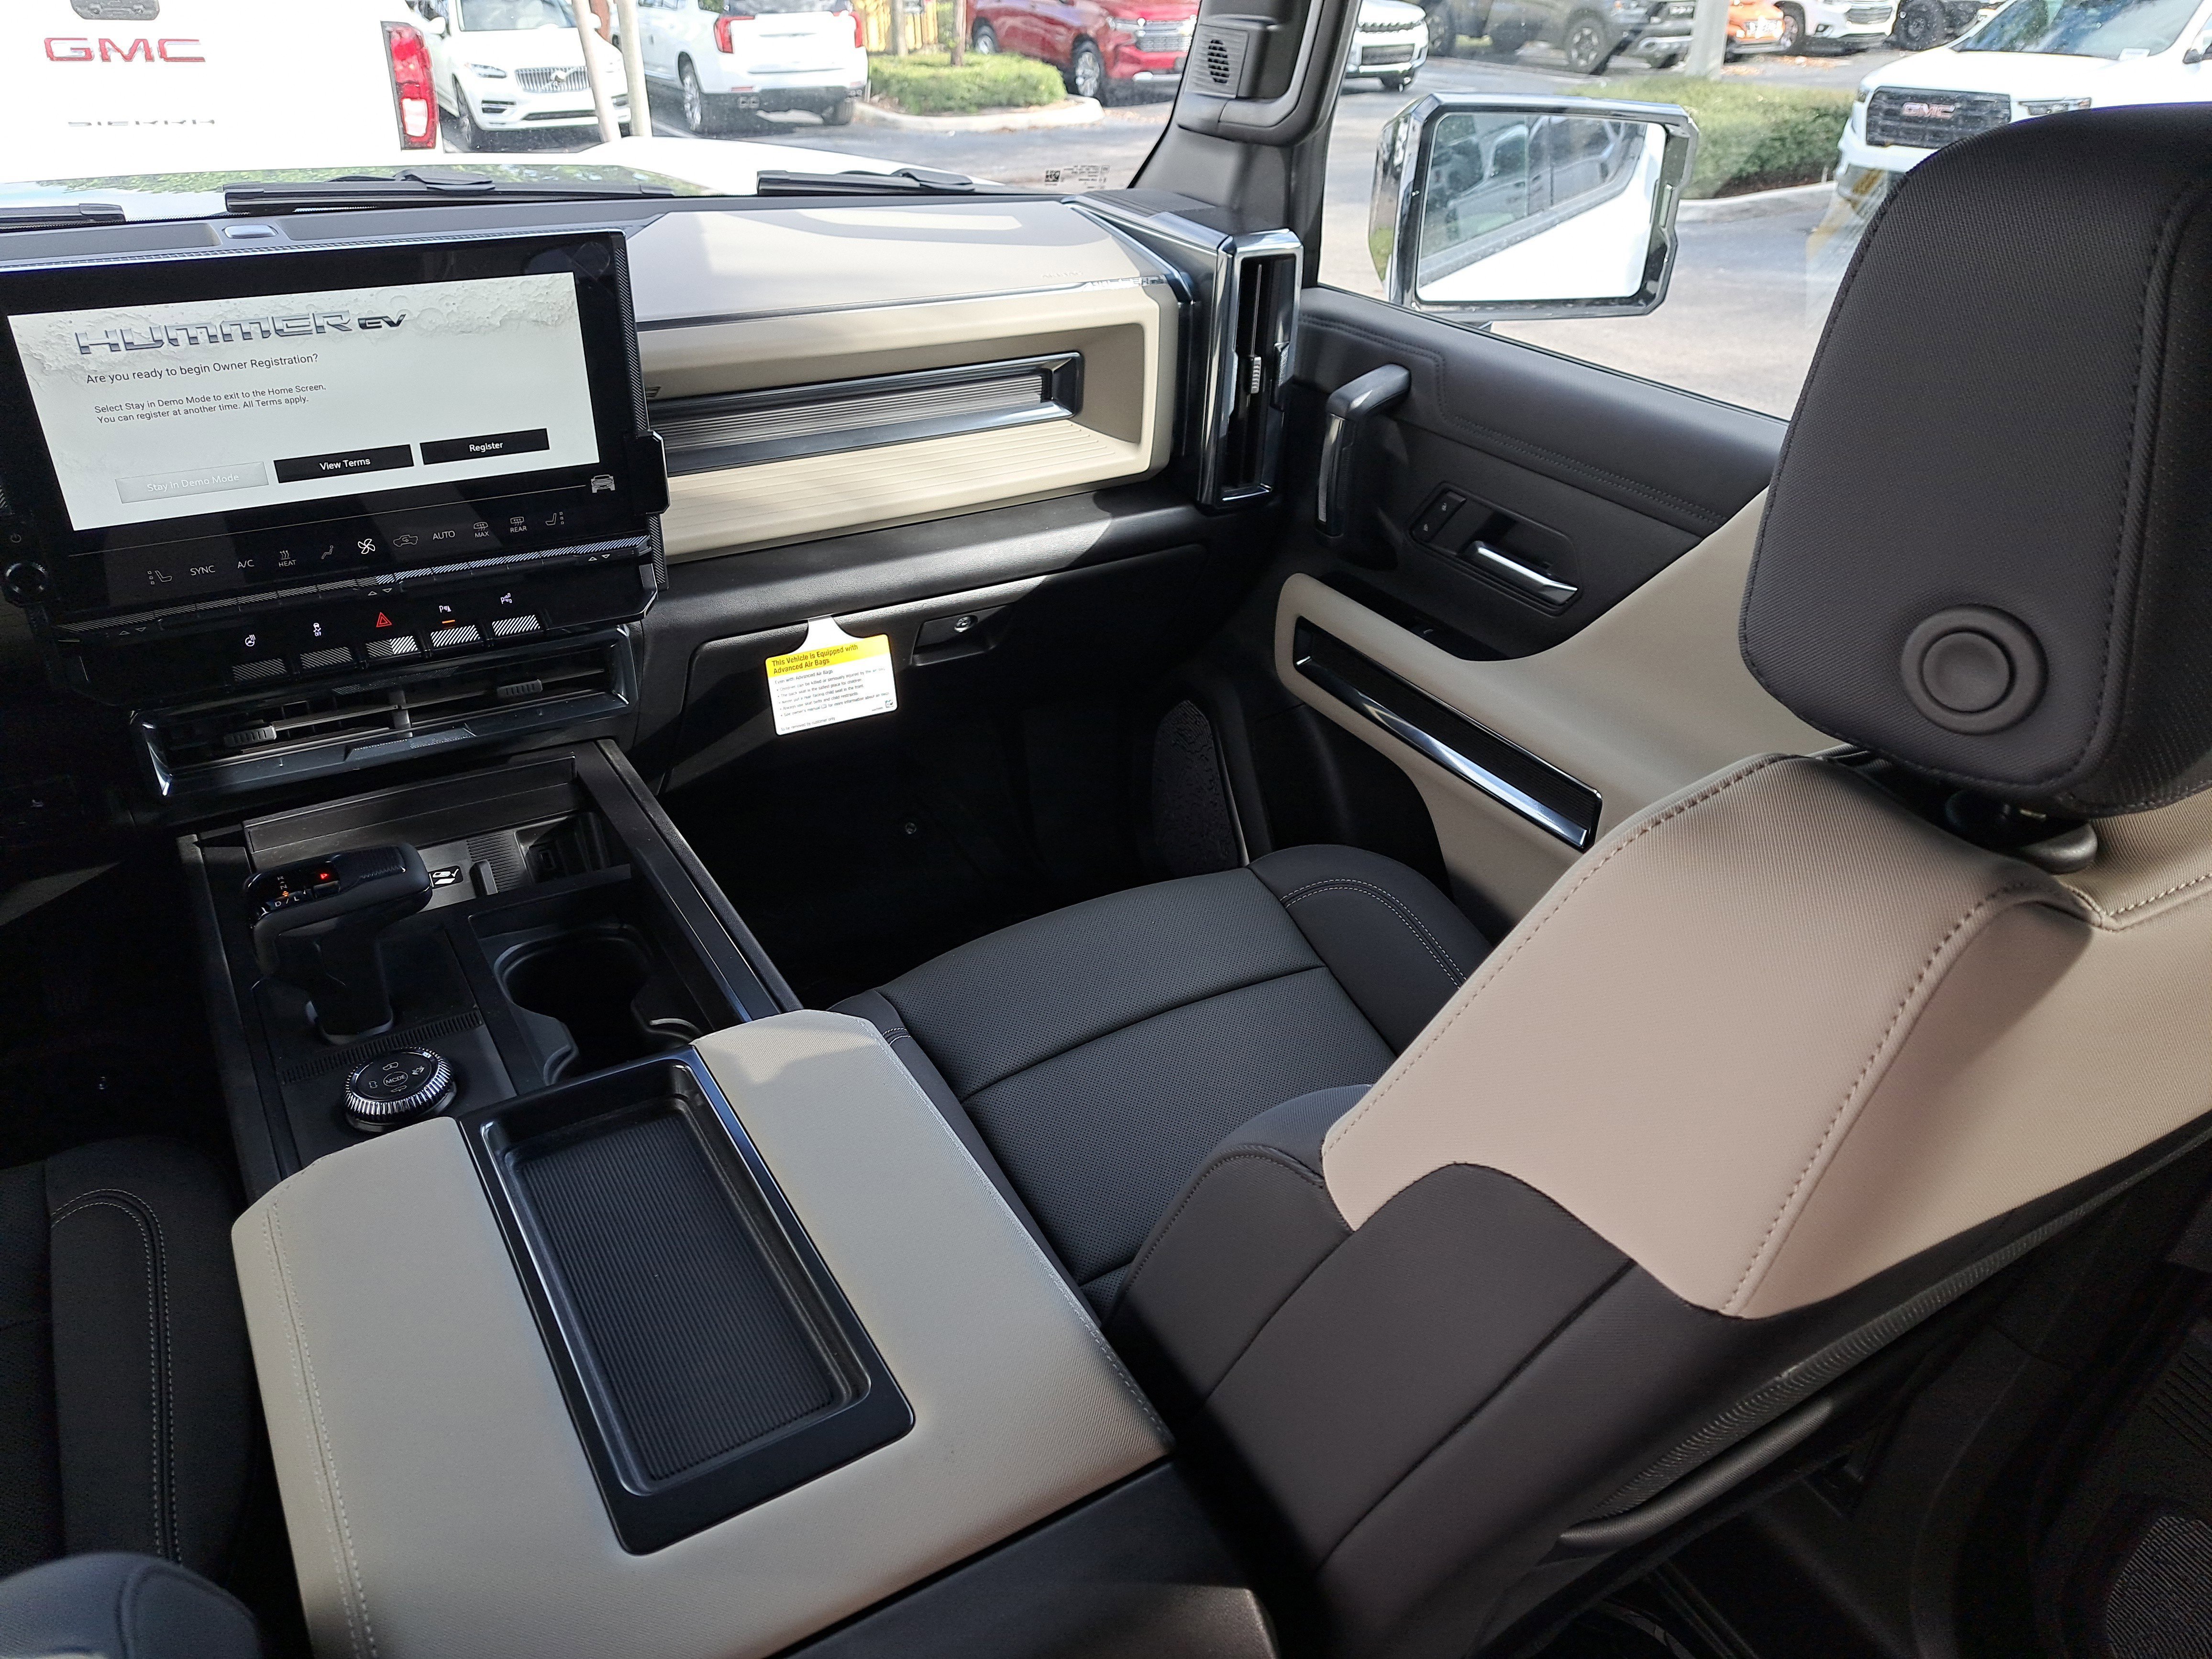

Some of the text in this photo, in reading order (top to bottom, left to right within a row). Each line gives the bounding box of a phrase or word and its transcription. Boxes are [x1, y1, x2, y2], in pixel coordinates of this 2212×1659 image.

[44, 37, 206, 62] GMC
[1902, 101, 1956, 119] GMC
[75, 310, 406, 354] HUMMER EV
[87, 354, 318, 384] Are you ready to begin Owner Registration?
[94, 404, 123, 413] Select
[125, 402, 144, 410] Stay
[157, 398, 184, 407] Demo
[186, 395, 211, 404] Mode
[213, 393, 221, 401] to
[224, 392, 240, 400] exit
[268, 387, 293, 396] Home
[295, 384, 326, 393] Screen.
[136, 411, 170, 420] register
[184, 406, 217, 415] another
[243, 400, 254, 409] All
[256, 398, 282, 407] Terms
[285, 395, 309, 405] apply.
[469, 442, 503, 453] Register
[319, 457, 371, 471] View Terms
[147, 473, 240, 493] Stay in Demo Mode
[432, 530, 455, 540] AUTO
[190, 565, 215, 576] SYNC
[237, 559, 254, 569] A/C
[278, 559, 297, 567] HEAT
[786, 654, 808, 664] Vehicle
[817, 646, 844, 657] Equipped
[774, 663, 803, 674] Advanced
[385, 1074, 407, 1084] MODE
